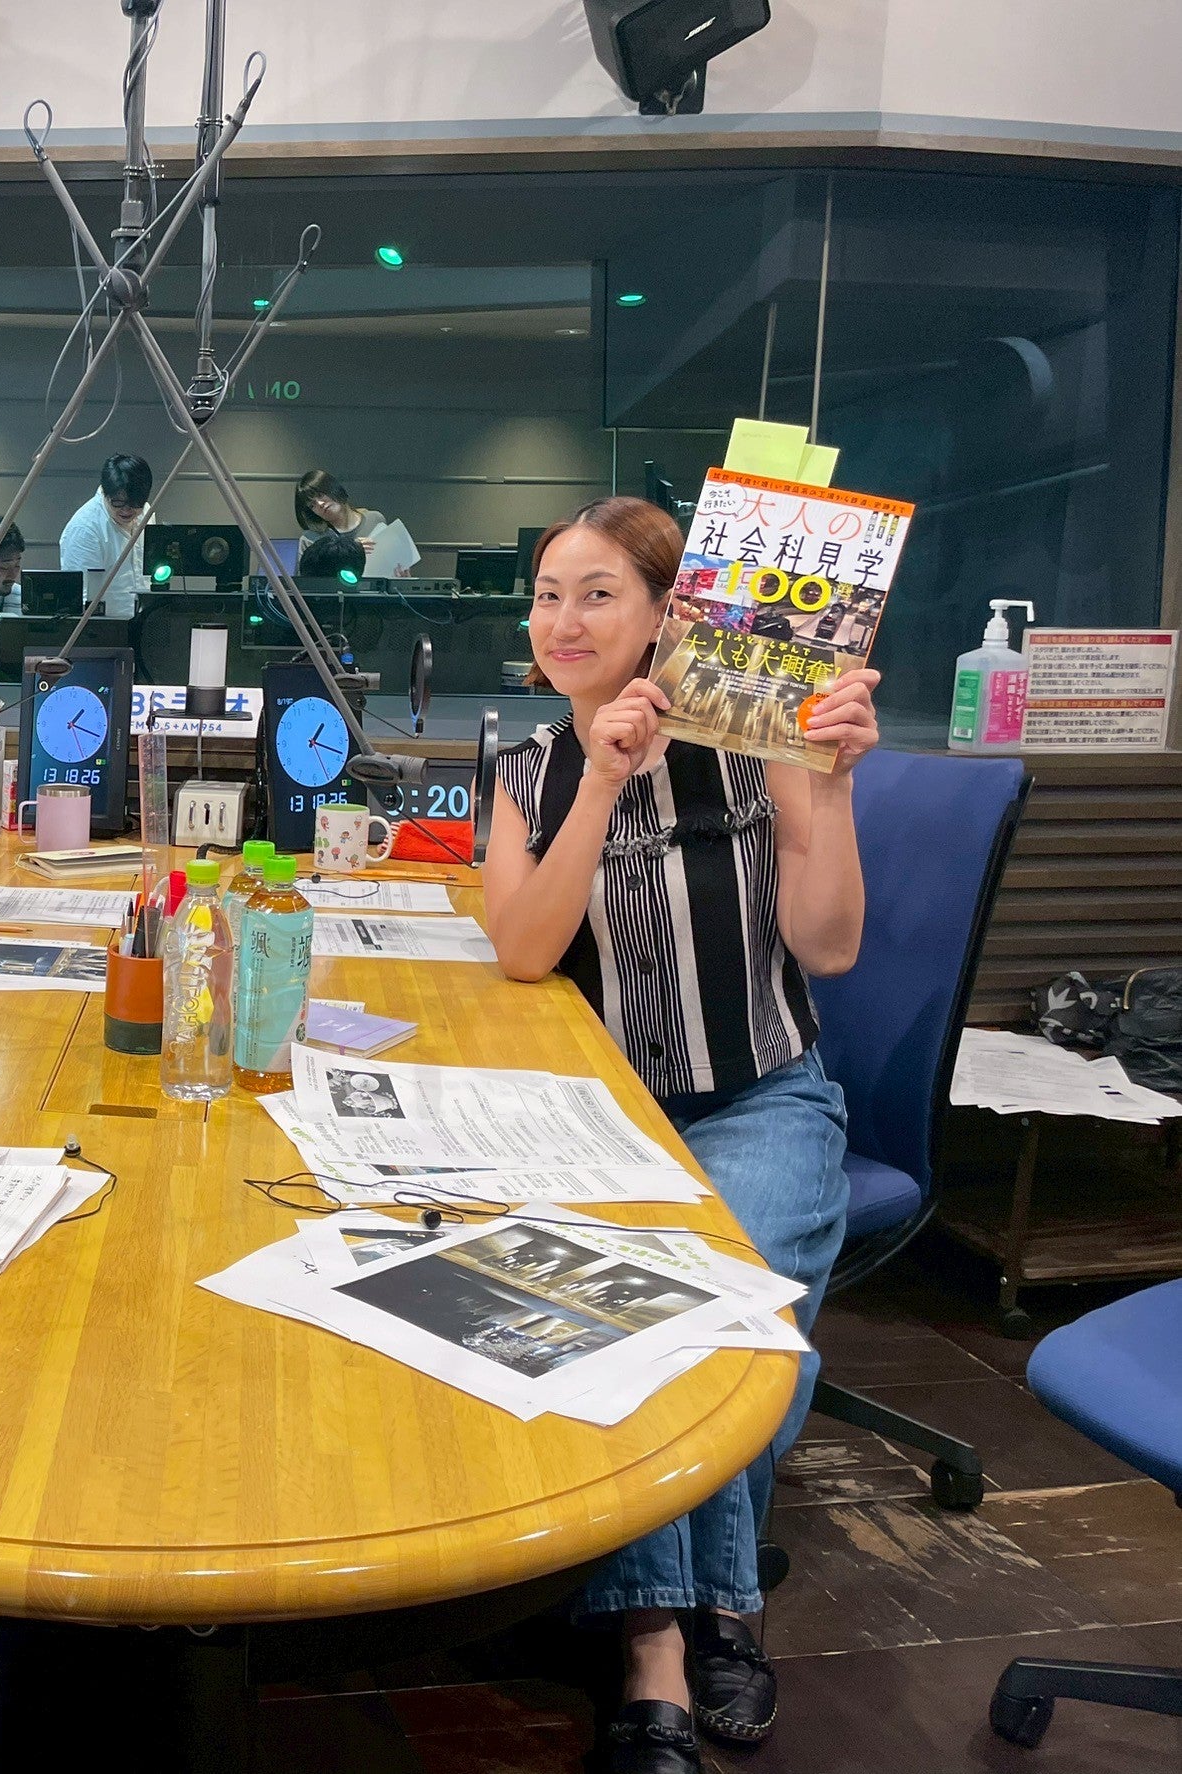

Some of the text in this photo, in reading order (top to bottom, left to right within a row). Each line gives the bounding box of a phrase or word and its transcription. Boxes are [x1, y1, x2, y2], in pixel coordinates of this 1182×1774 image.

[736, 493, 862, 541] 大人の
[700, 519, 884, 588] 社会科見学
[43, 768, 100, 784] 13 18 26
[290, 795, 304, 812] 13
[386, 785, 469, 818] :20
[251, 930, 270, 958] 颯
